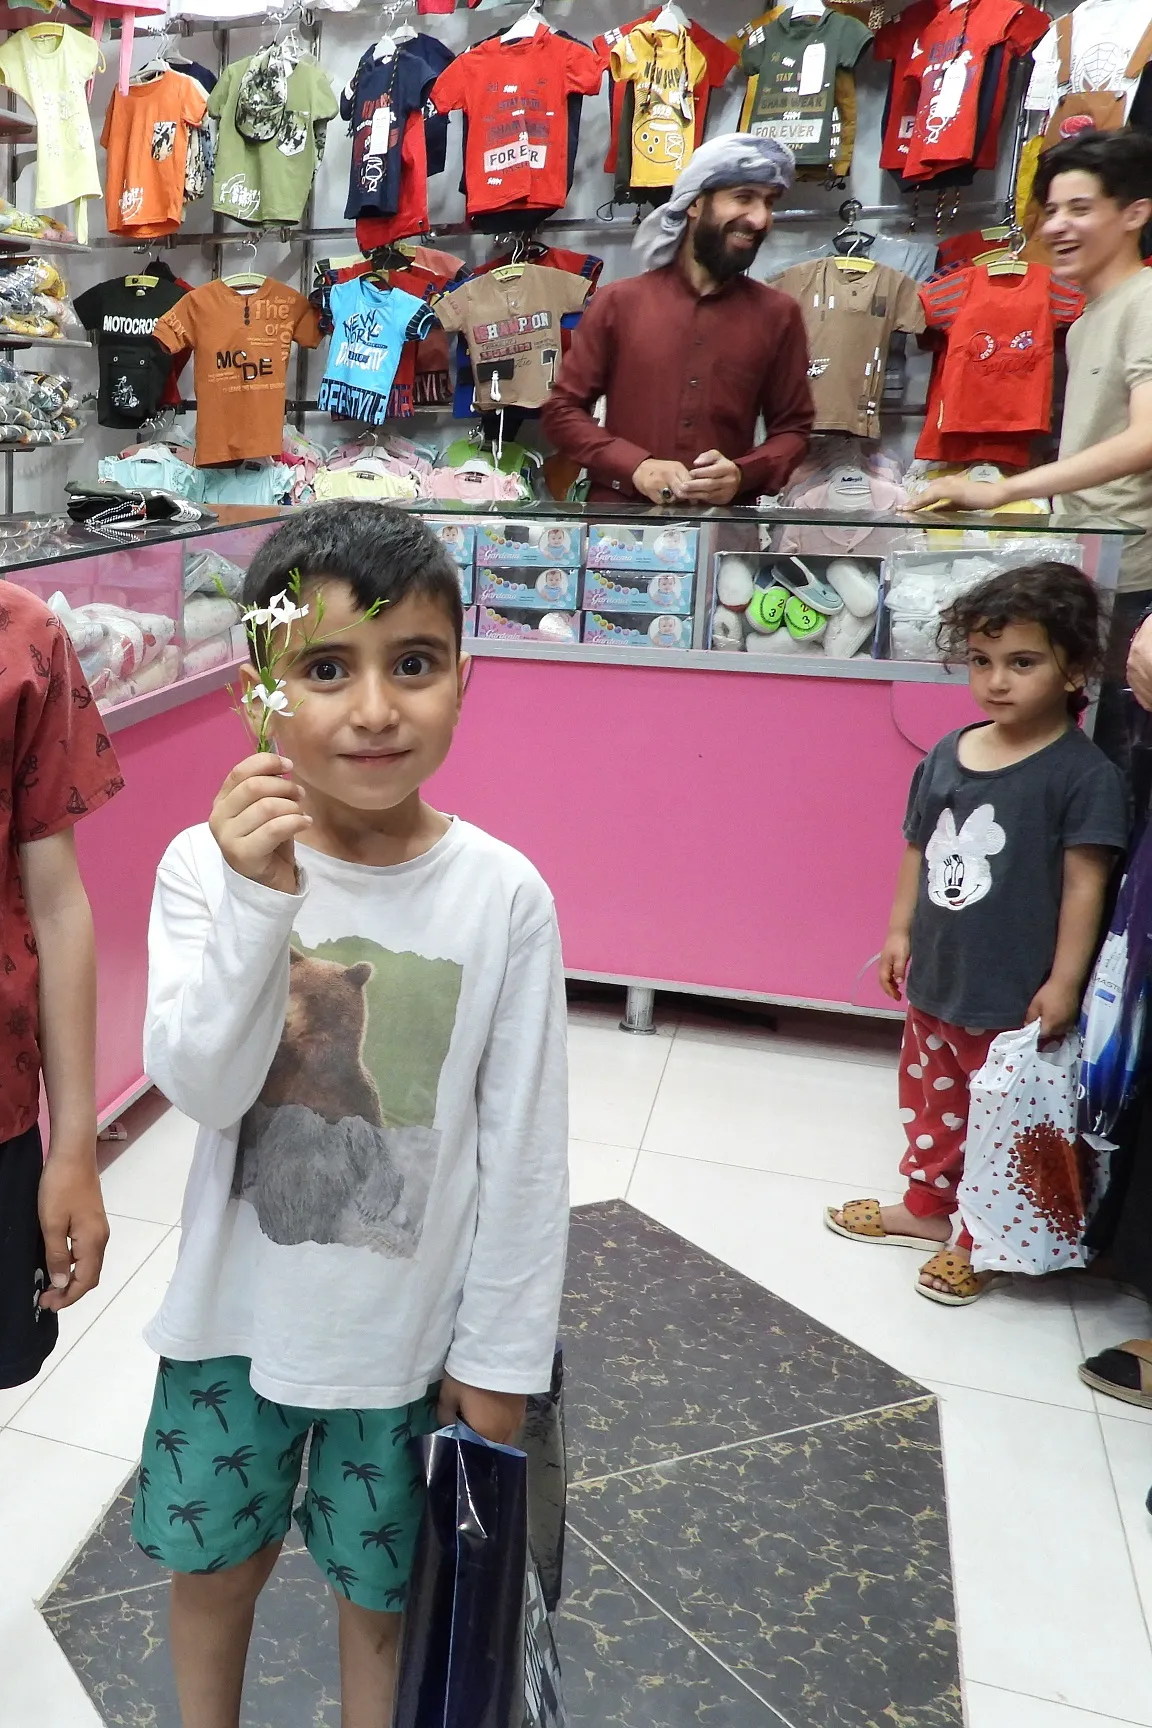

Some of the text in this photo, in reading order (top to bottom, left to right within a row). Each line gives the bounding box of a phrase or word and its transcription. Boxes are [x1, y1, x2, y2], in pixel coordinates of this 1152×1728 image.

[254, 299, 290, 320] The
[342, 309, 378, 335] NEW
[473, 311, 550, 343] CHAMPION
[216, 350, 274, 381] MODE
[768, 608, 777, 618] 3
[777, 598, 785, 608] 2
[801, 615, 811, 625] 3
[1094, 974, 1124, 994] MASTE
